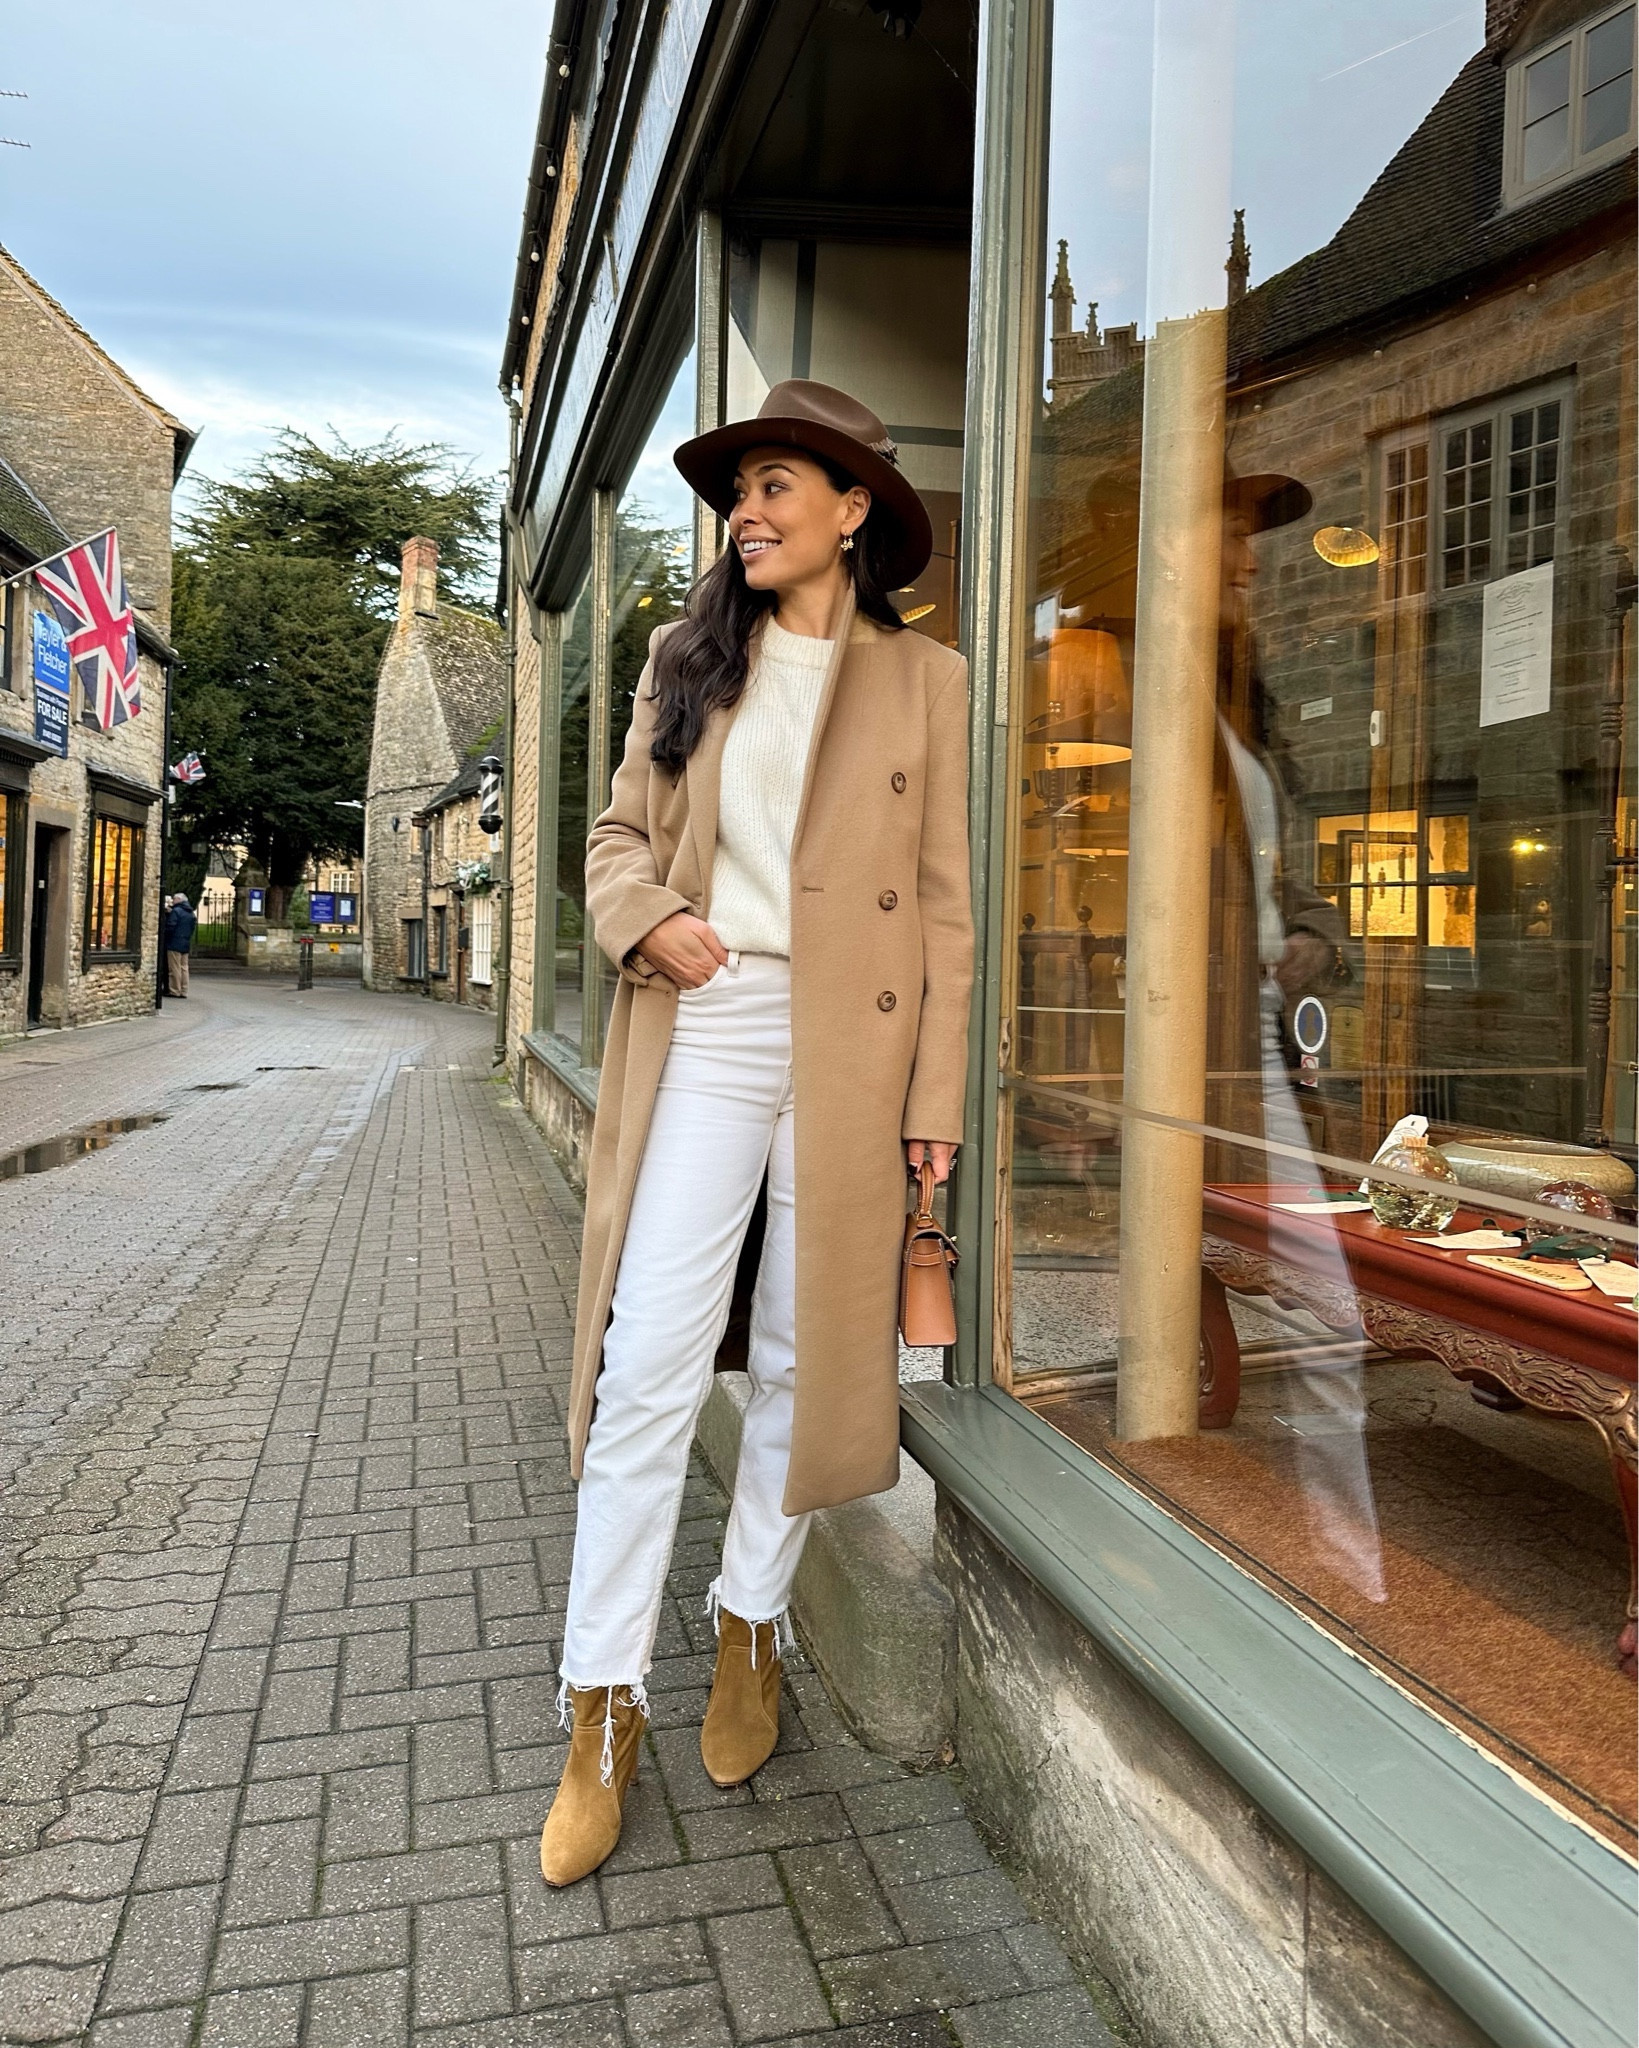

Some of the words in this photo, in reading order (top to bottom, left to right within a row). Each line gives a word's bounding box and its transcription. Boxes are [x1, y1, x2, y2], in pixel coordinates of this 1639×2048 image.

[38, 643, 67, 675] Fletcher
[38, 699, 51, 718] FOR
[51, 705, 67, 726] SALE
